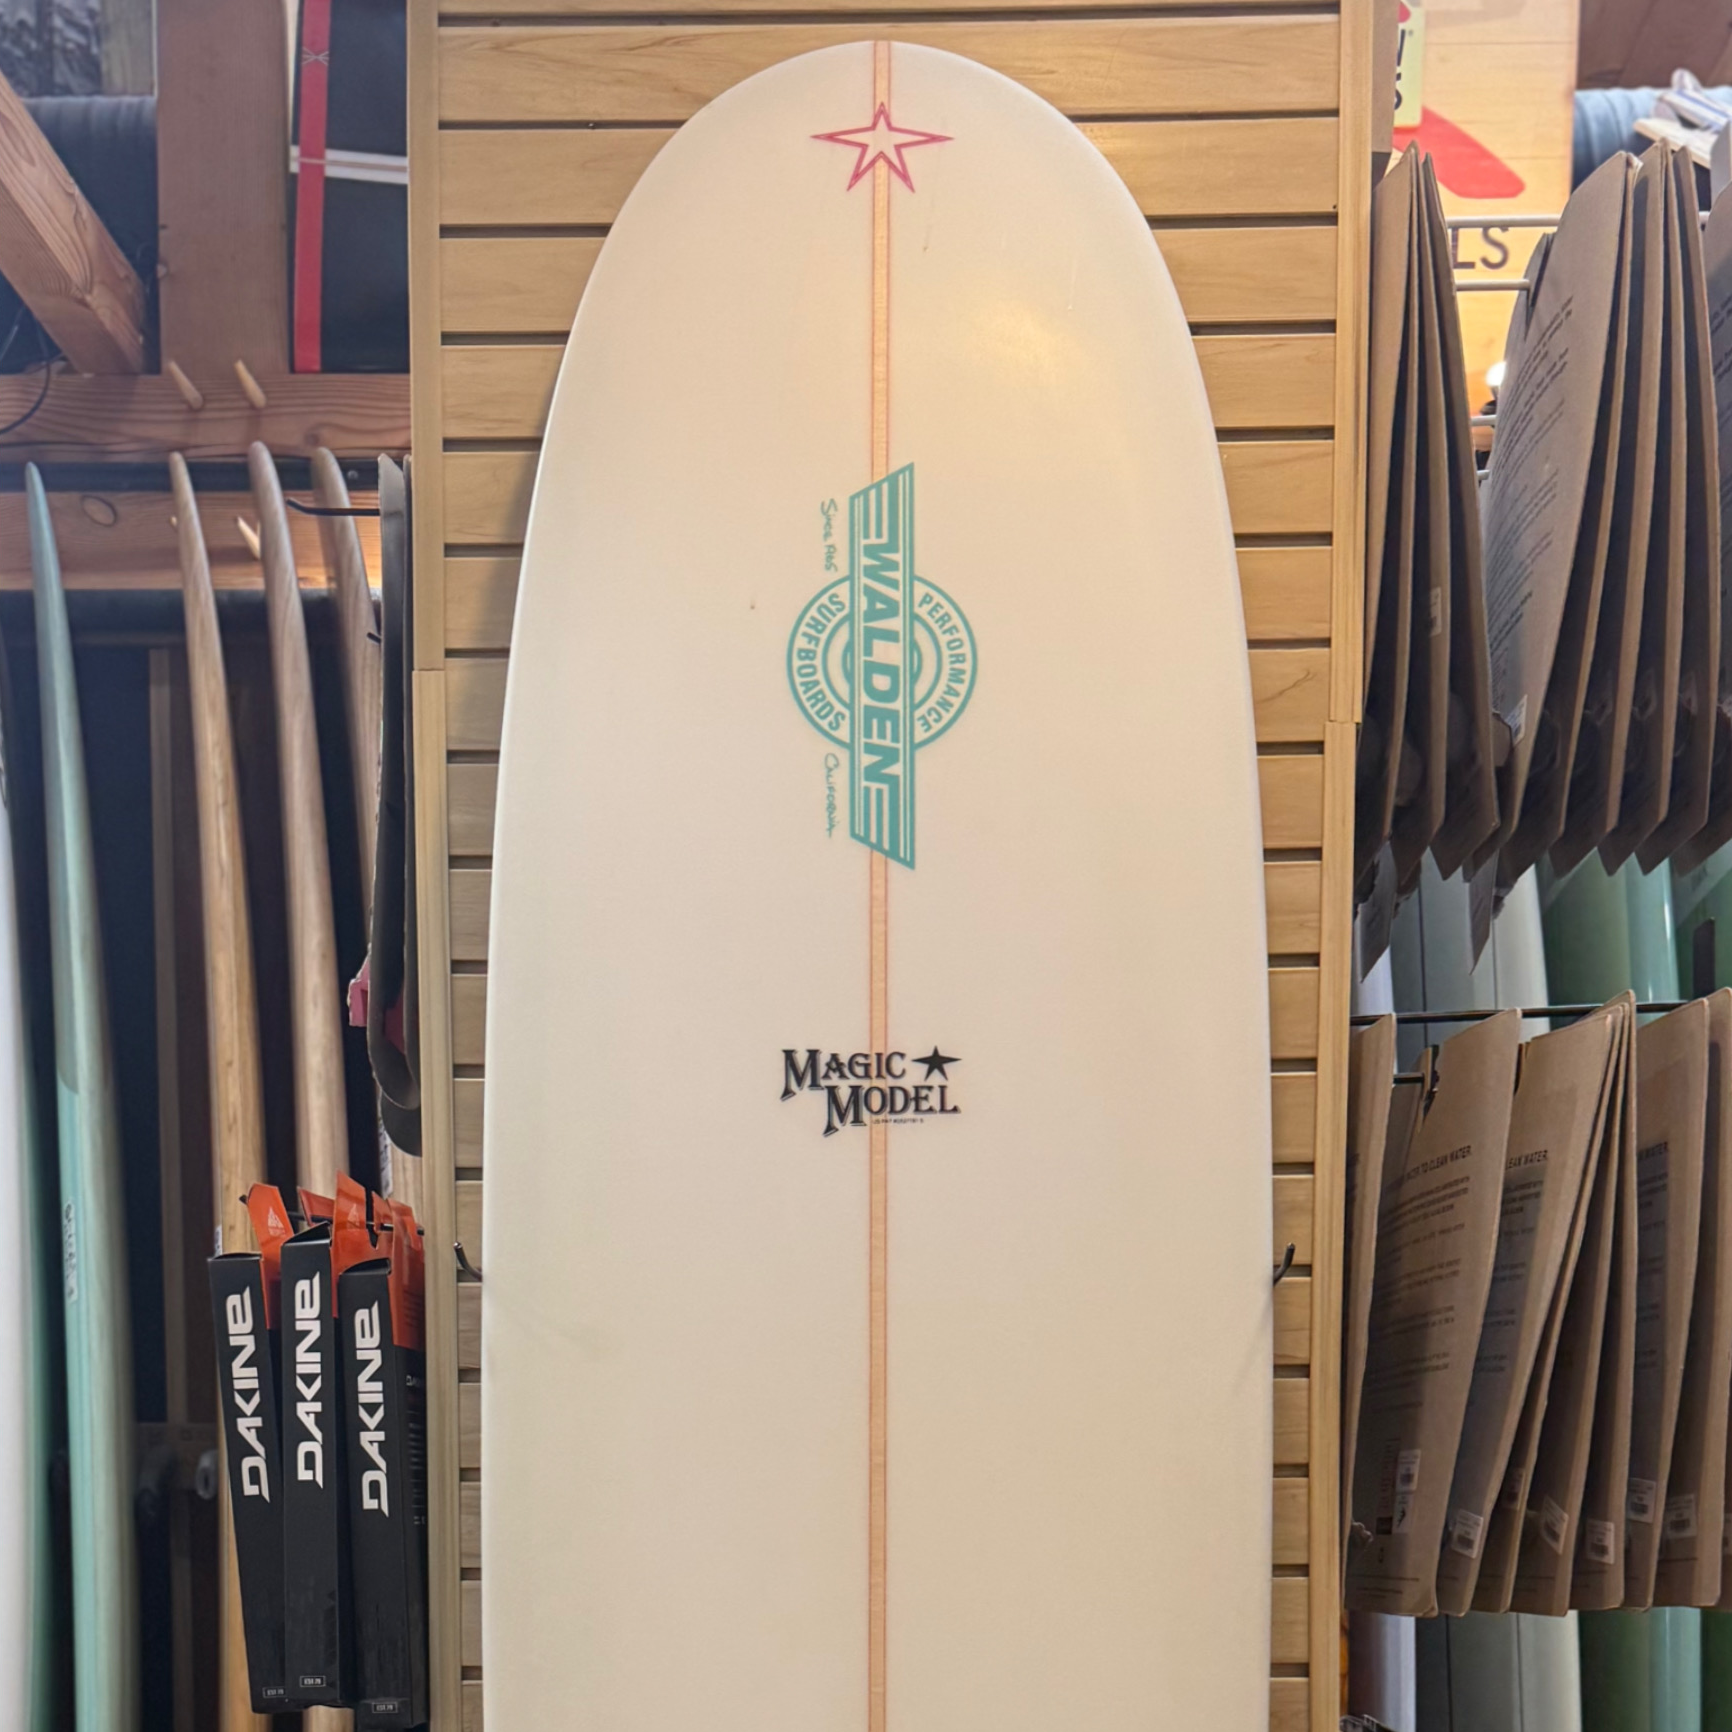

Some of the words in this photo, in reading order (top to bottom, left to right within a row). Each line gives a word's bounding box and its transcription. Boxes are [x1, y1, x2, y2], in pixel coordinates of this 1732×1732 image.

[796, 592, 846, 733] SURFBOARDS
[863, 541, 901, 783] WALDEN
[918, 592, 967, 733] PERFORMANCE
[226, 1285, 270, 1503] DAKINE
[295, 1270, 323, 1490] DAKINE
[356, 1300, 390, 1517] DAKINE
